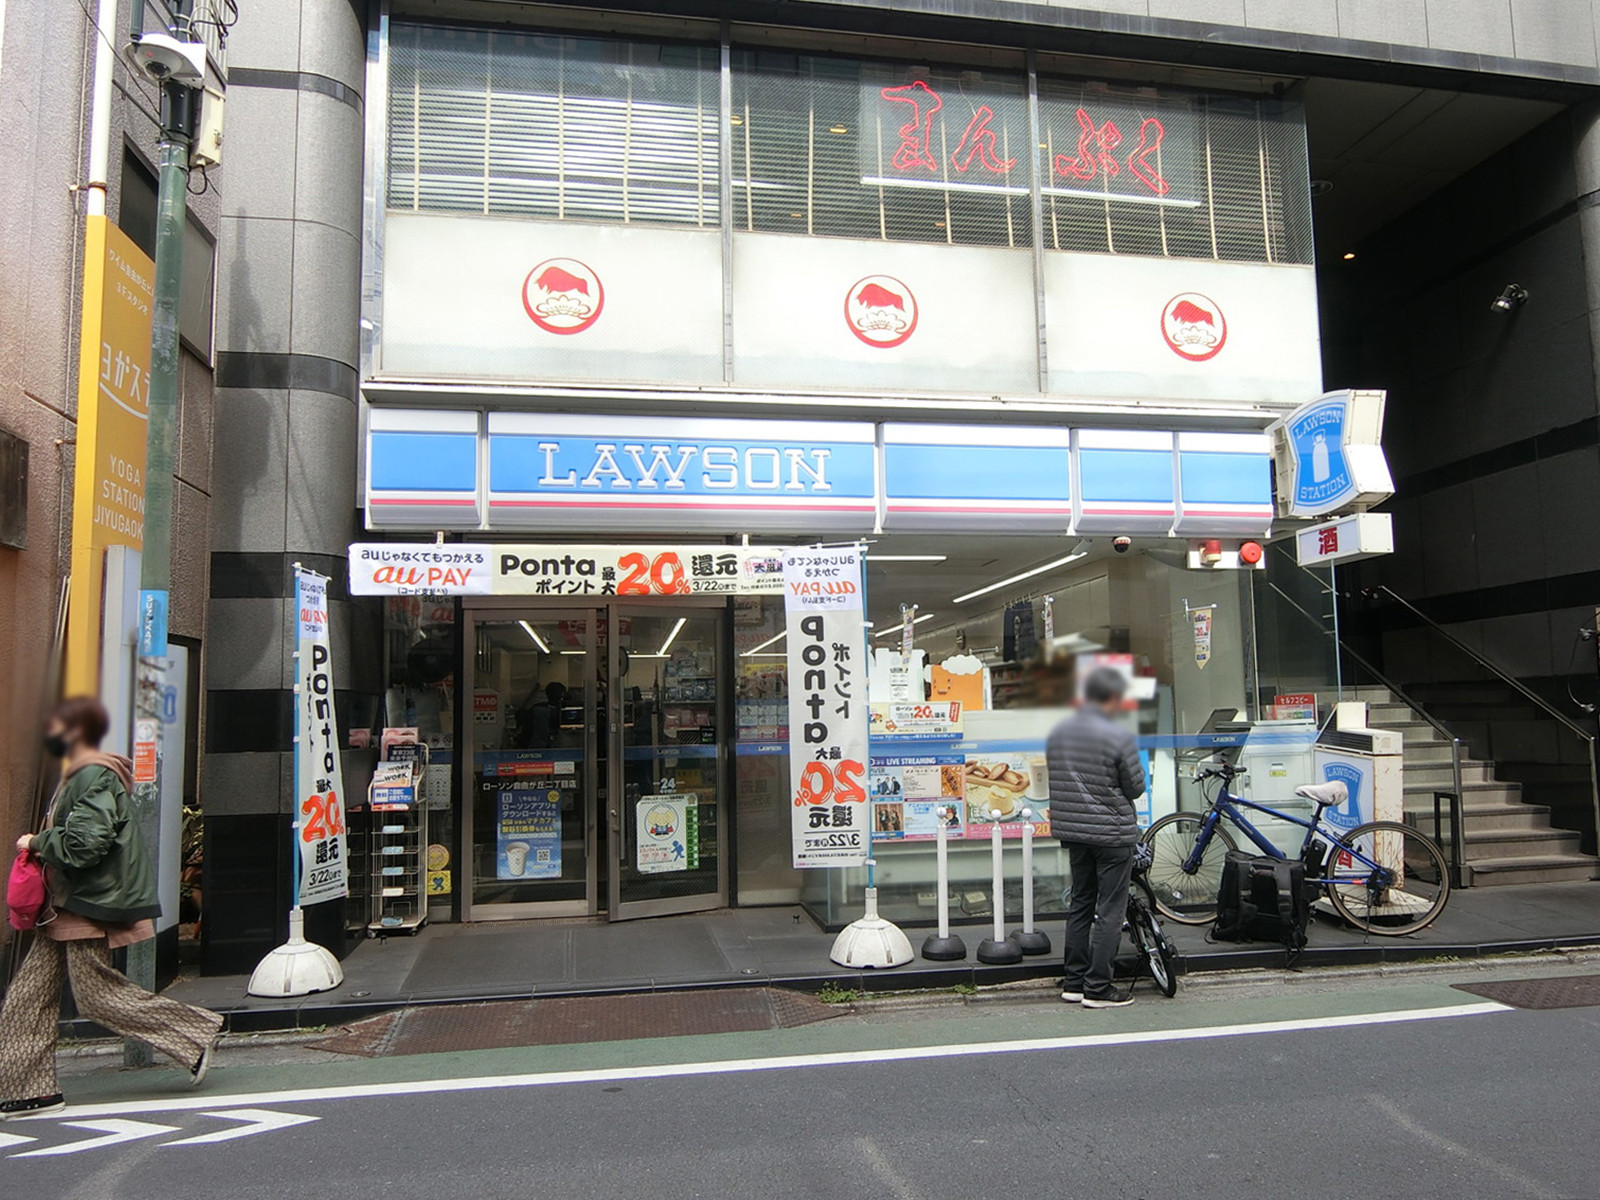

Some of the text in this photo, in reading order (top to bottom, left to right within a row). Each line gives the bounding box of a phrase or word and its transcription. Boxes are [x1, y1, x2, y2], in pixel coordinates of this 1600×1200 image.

[1294, 409, 1343, 439] LAWSON
[110, 454, 141, 487] YOGA
[537, 442, 832, 491] LAWSON
[102, 479, 145, 515] STATION
[1300, 473, 1347, 500] STATION
[94, 504, 144, 540] JIYUGAOK
[1318, 527, 1338, 555] 酒
[361, 549, 484, 563] auじゃなくてもつかえる
[500, 555, 595, 576] Ponta
[692, 554, 737, 577] 還元
[372, 566, 472, 586] au PAY
[601, 567, 616, 596] 最大
[617, 552, 690, 596] 20%
[536, 579, 595, 595] ポイント
[312, 644, 335, 774] Ponta
[1280, 697, 1309, 705] セルフコピー
[901, 756, 936, 764] STREAMING
[316, 778, 333, 793] 最大
[482, 780, 577, 791] ローソン自由が丘二丁目店
[660, 778, 676, 789] 24
[1326, 767, 1360, 784] LAWSON
[302, 791, 345, 842] 20%
[1327, 810, 1360, 828] STATION
[1034, 823, 1049, 836] 20
[316, 838, 339, 865] 還元
